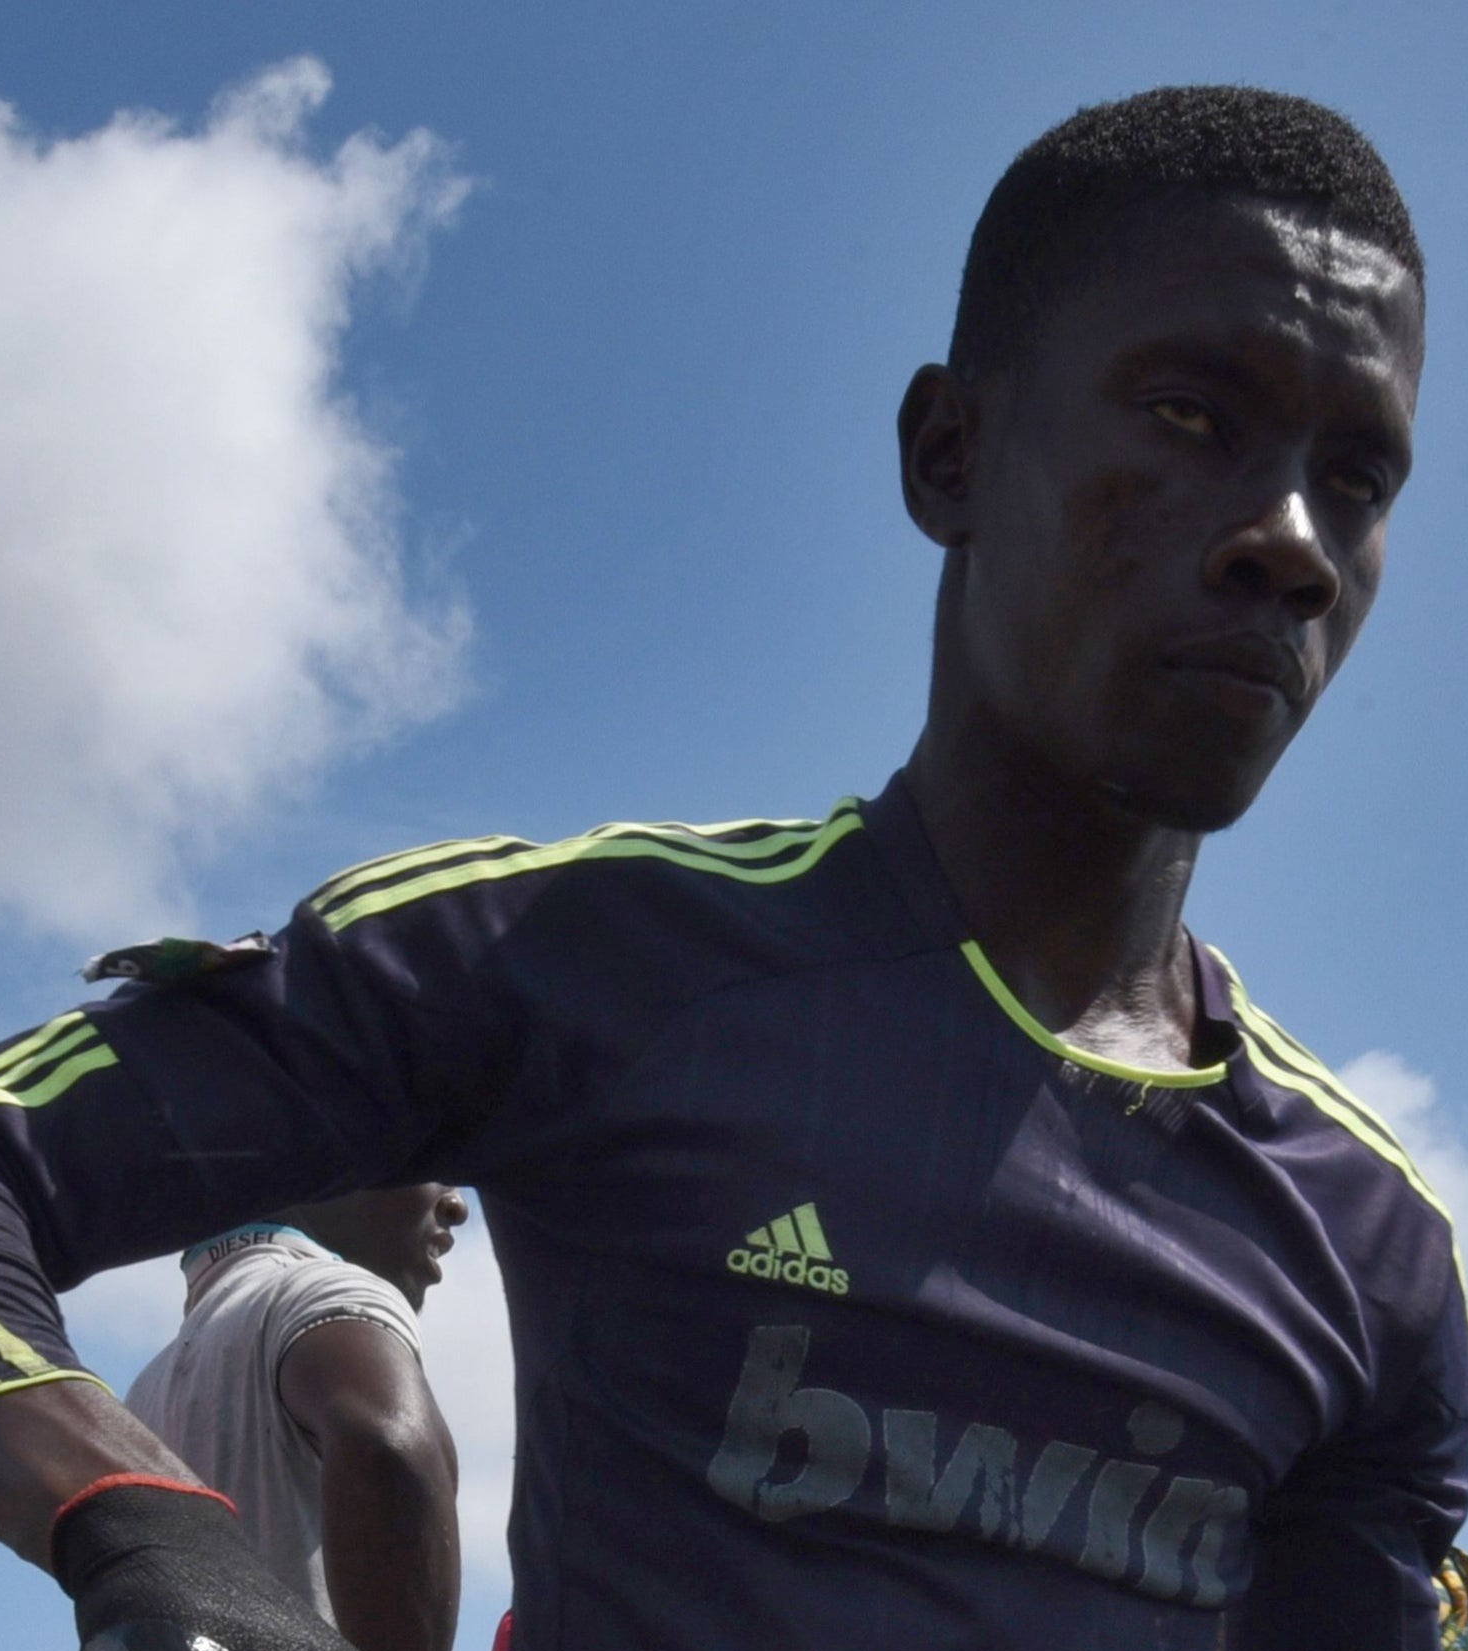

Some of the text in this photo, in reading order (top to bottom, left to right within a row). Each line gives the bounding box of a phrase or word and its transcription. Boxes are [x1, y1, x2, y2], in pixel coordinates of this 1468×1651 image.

[208, 1231, 276, 1264] DIESEL
[726, 1247, 850, 1295] adidas
[707, 1324, 1254, 1609] bwin
